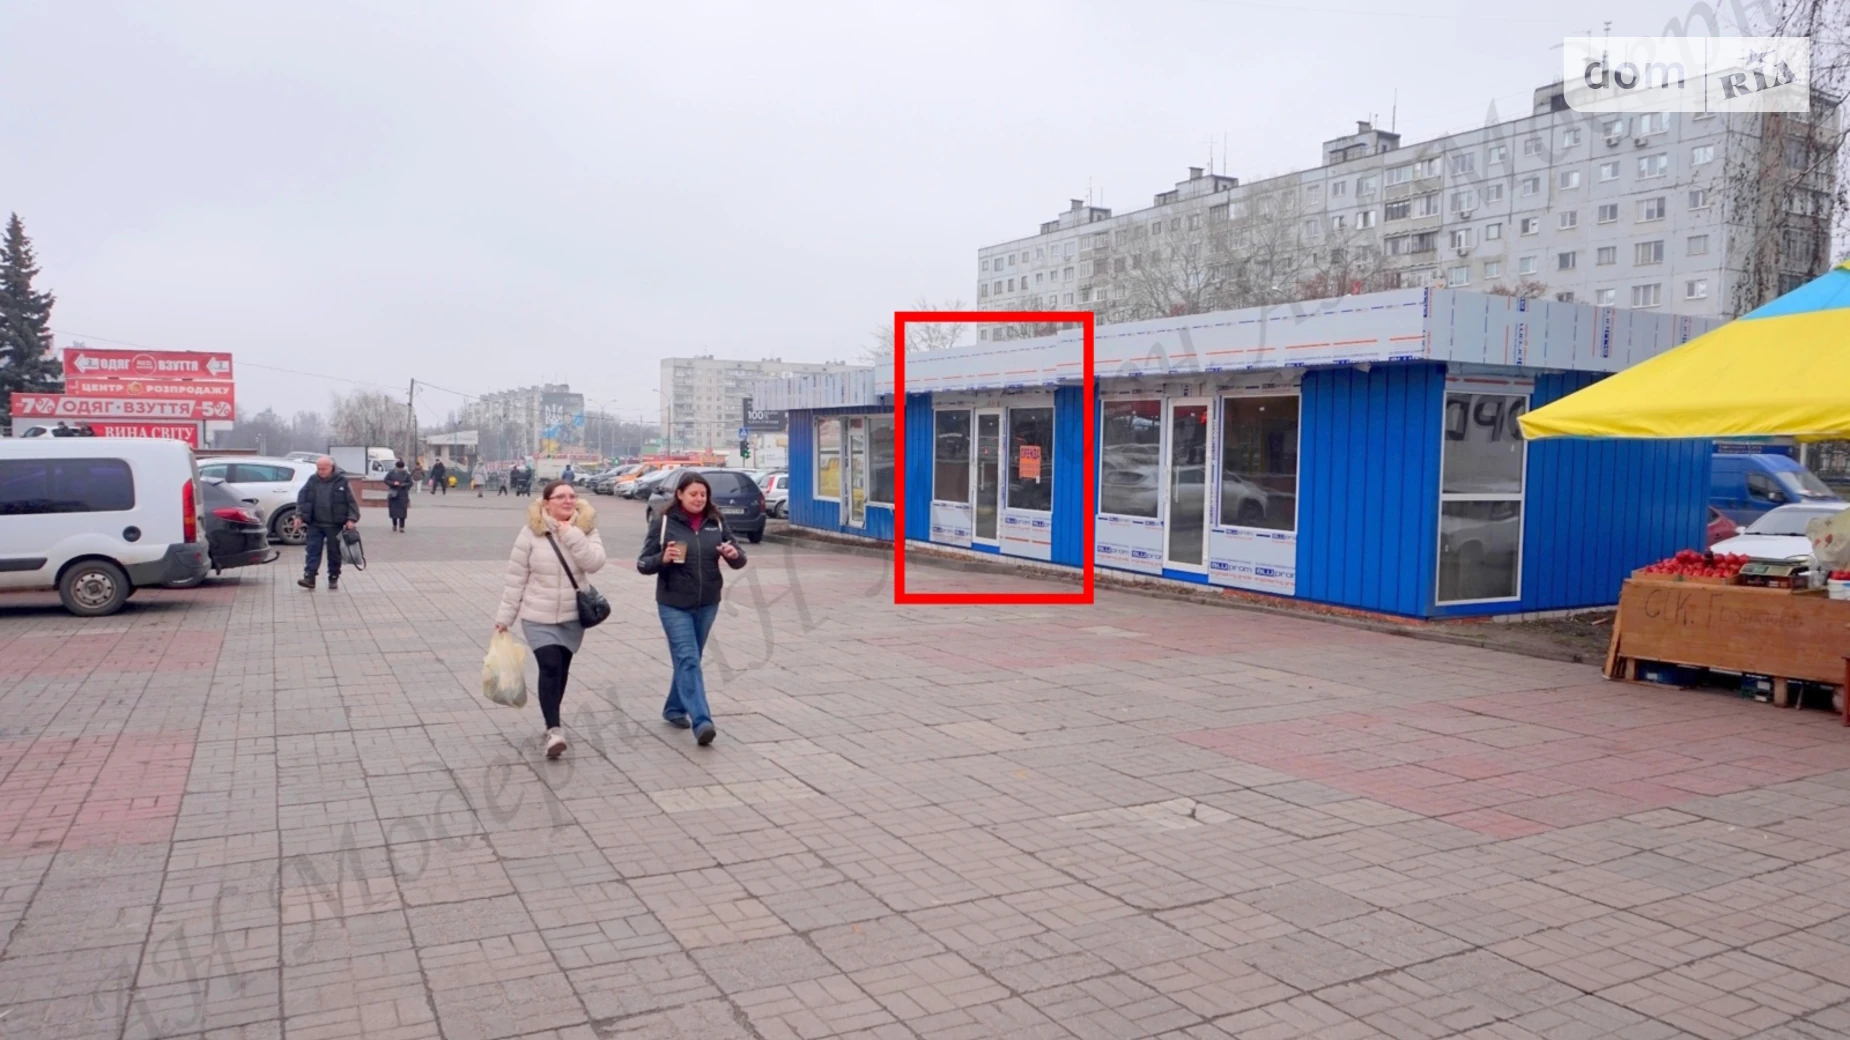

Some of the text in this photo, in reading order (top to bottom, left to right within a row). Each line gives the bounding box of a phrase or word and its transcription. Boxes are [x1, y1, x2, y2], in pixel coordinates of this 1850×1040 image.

[100, 358, 131, 370] ОДЯГ
[158, 360, 199, 371] ВЗУТТЯ
[82, 383, 230, 395] ЦЕНТР РОЗПРОДАЖУ
[63, 401, 114, 413] ОДЯГ
[123, 402, 190, 414] ВЗУТТЯ
[748, 411, 763, 419] 100
[104, 426, 194, 440] ВИНА СВІТУ
